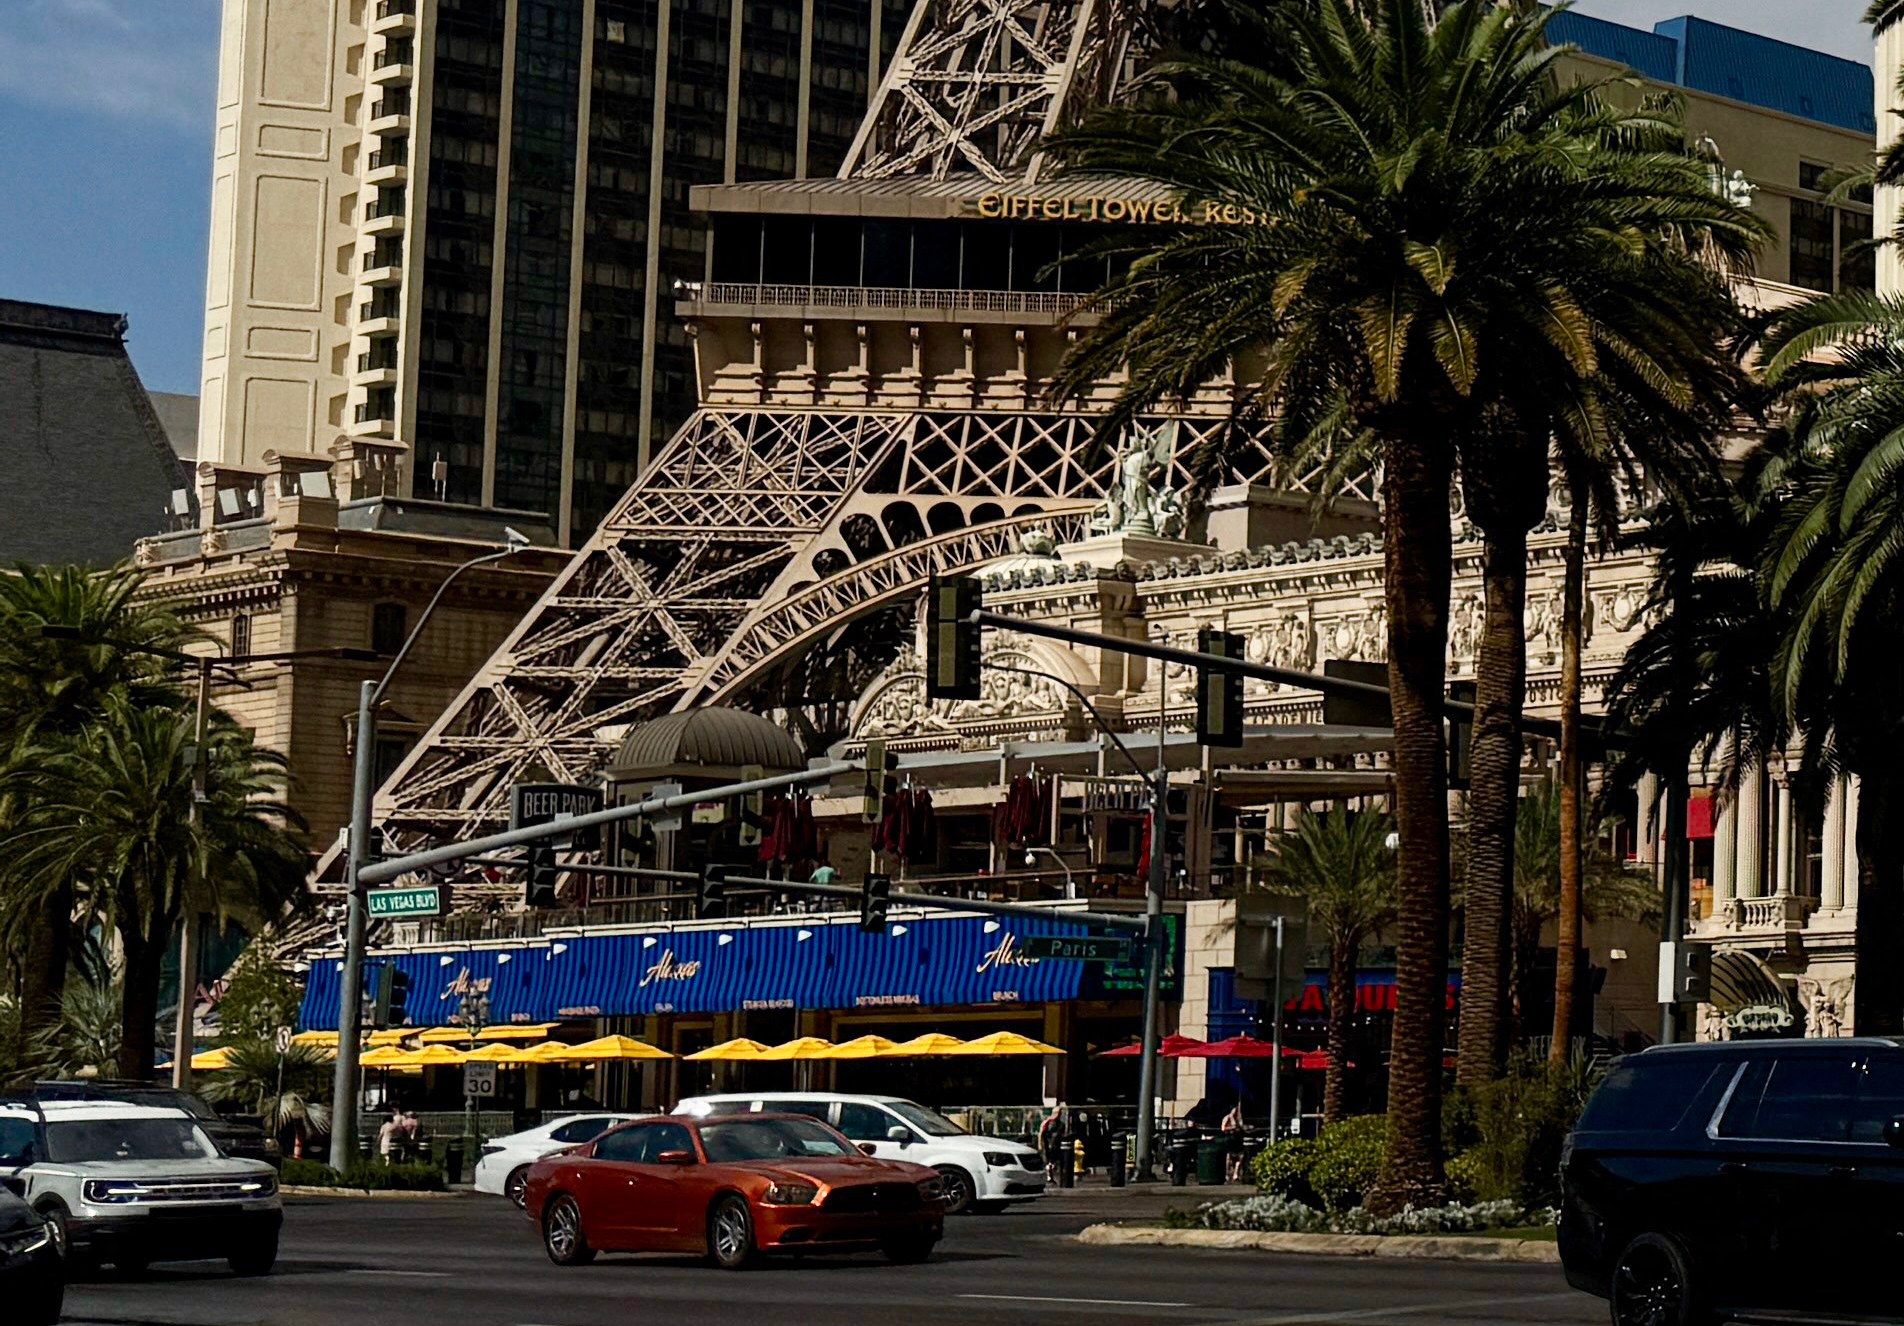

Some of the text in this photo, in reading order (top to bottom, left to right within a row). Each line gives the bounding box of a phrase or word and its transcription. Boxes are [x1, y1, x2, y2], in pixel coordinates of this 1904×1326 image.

[978, 192, 1081, 222] EIFFEL
[524, 791, 598, 819] BEER PARK
[371, 892, 436, 912] LAS VEGAS BLVD
[1050, 940, 1097, 957] Paris
[468, 1079, 492, 1094] 30
